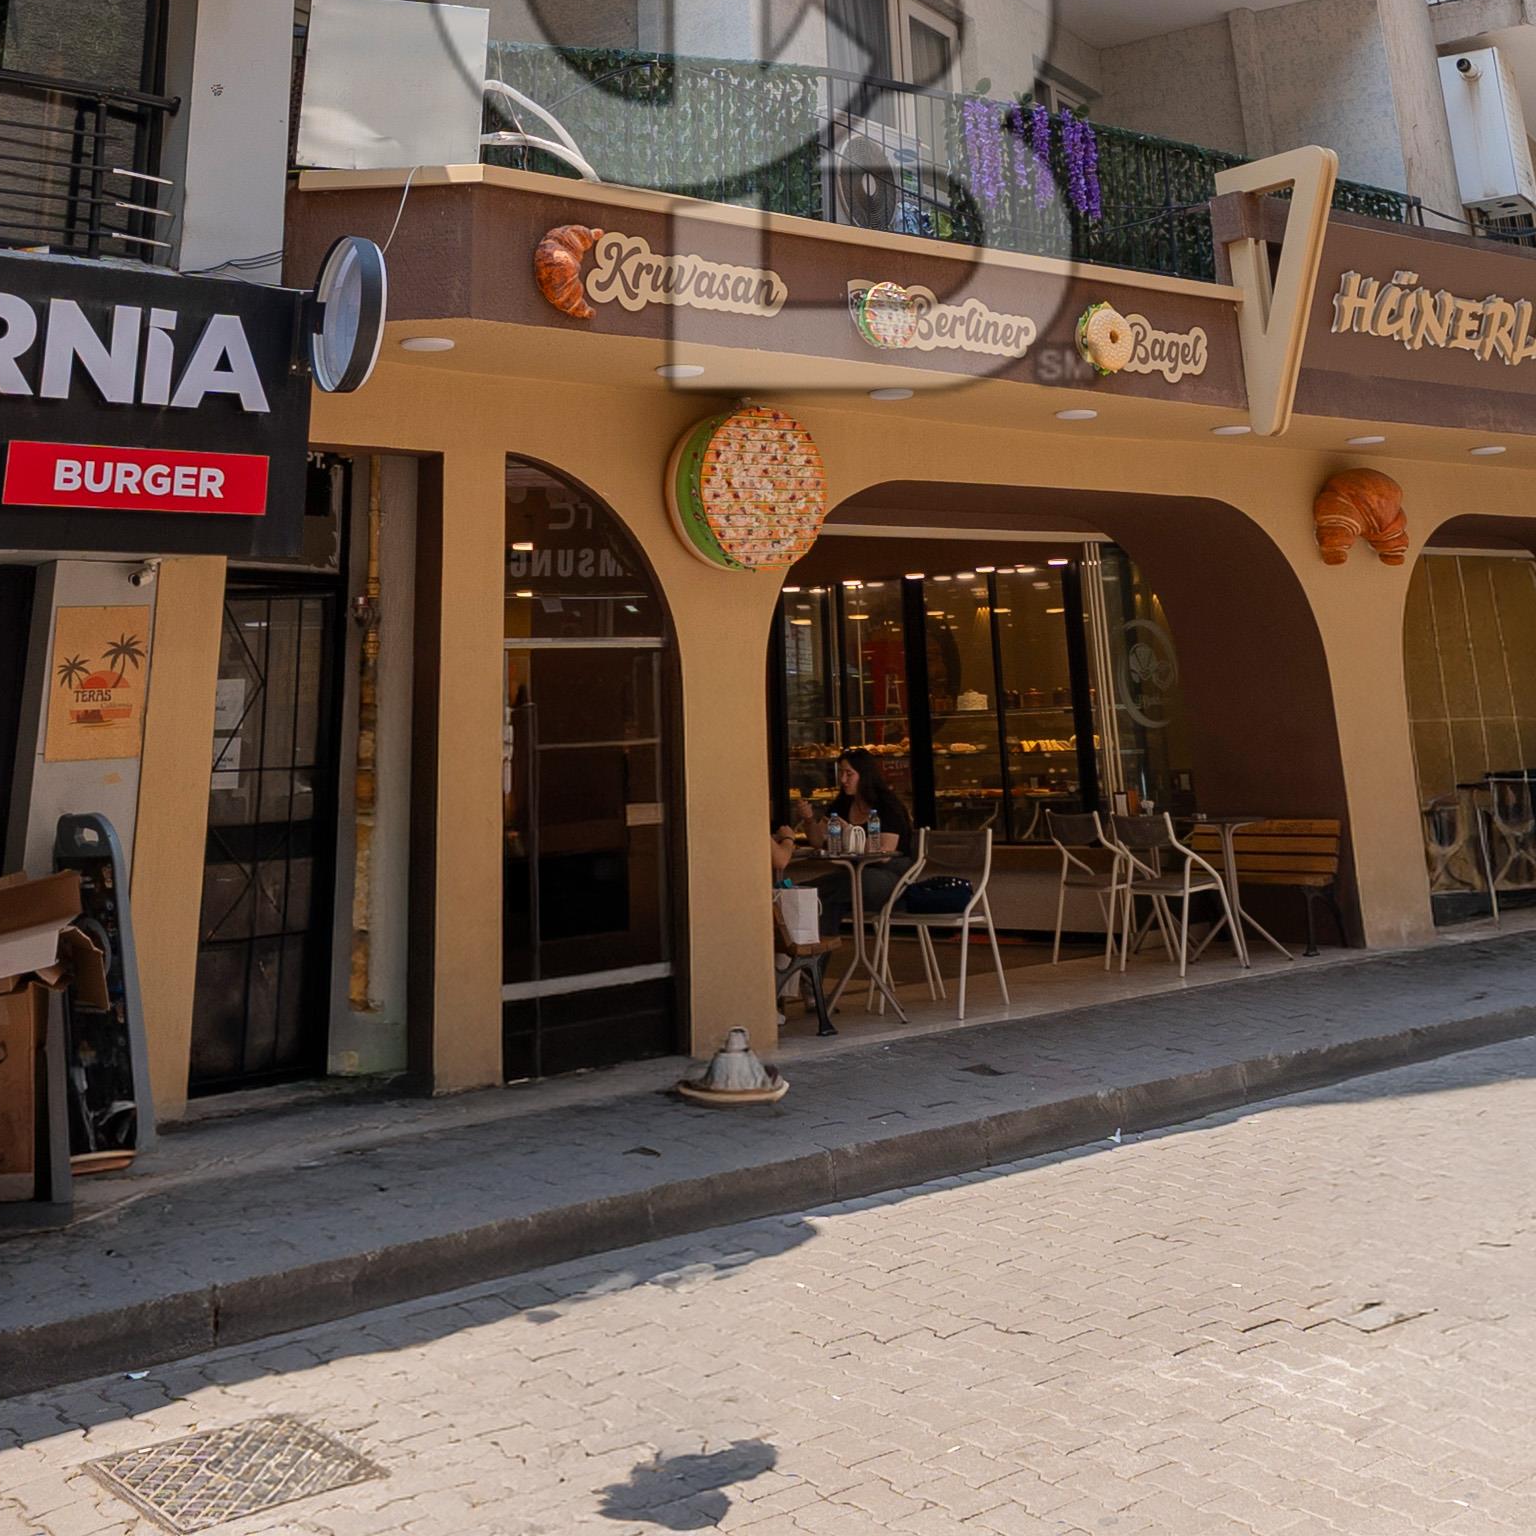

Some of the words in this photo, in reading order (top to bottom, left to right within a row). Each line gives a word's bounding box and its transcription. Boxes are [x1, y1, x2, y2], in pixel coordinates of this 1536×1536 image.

[593, 235, 779, 308] Kruvasan
[910, 288, 1032, 353] Berliner
[1128, 324, 1202, 377] Bagel
[53, 459, 225, 500] BURGER
[74, 689, 112, 702] TERAS
